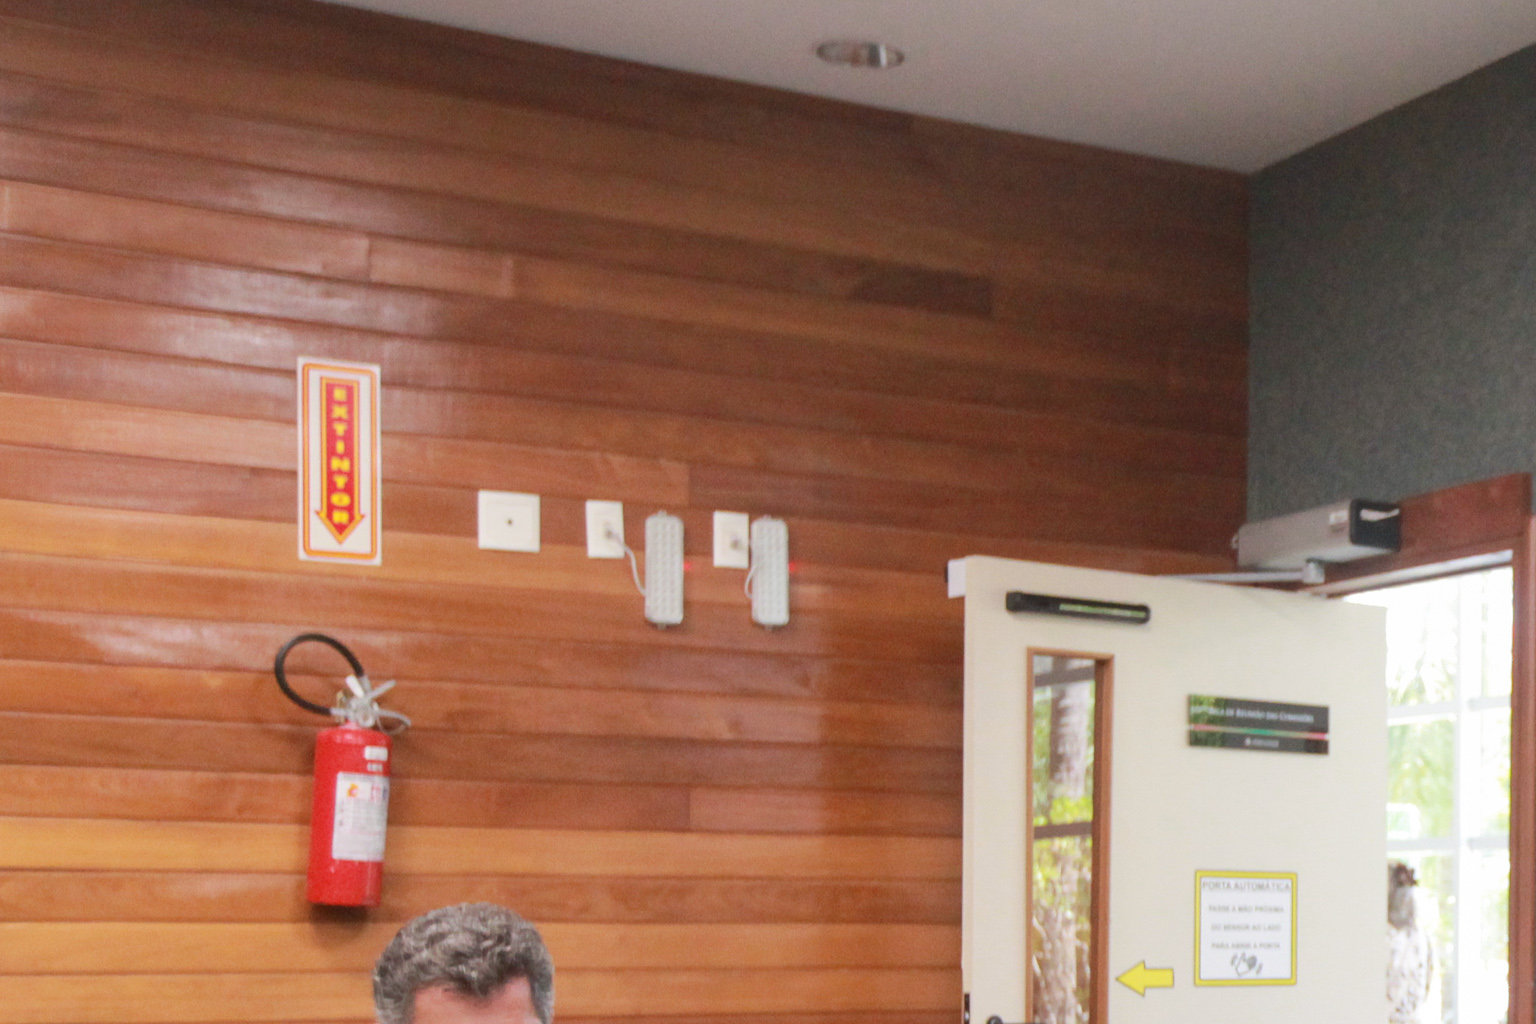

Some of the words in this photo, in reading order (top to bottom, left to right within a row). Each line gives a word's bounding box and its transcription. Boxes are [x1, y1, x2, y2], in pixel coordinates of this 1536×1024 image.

[330, 386, 351, 525] EXTINTOR
[1202, 881, 1231, 891] PORTA
[1233, 880, 1291, 892] AUTOMÁTICA
